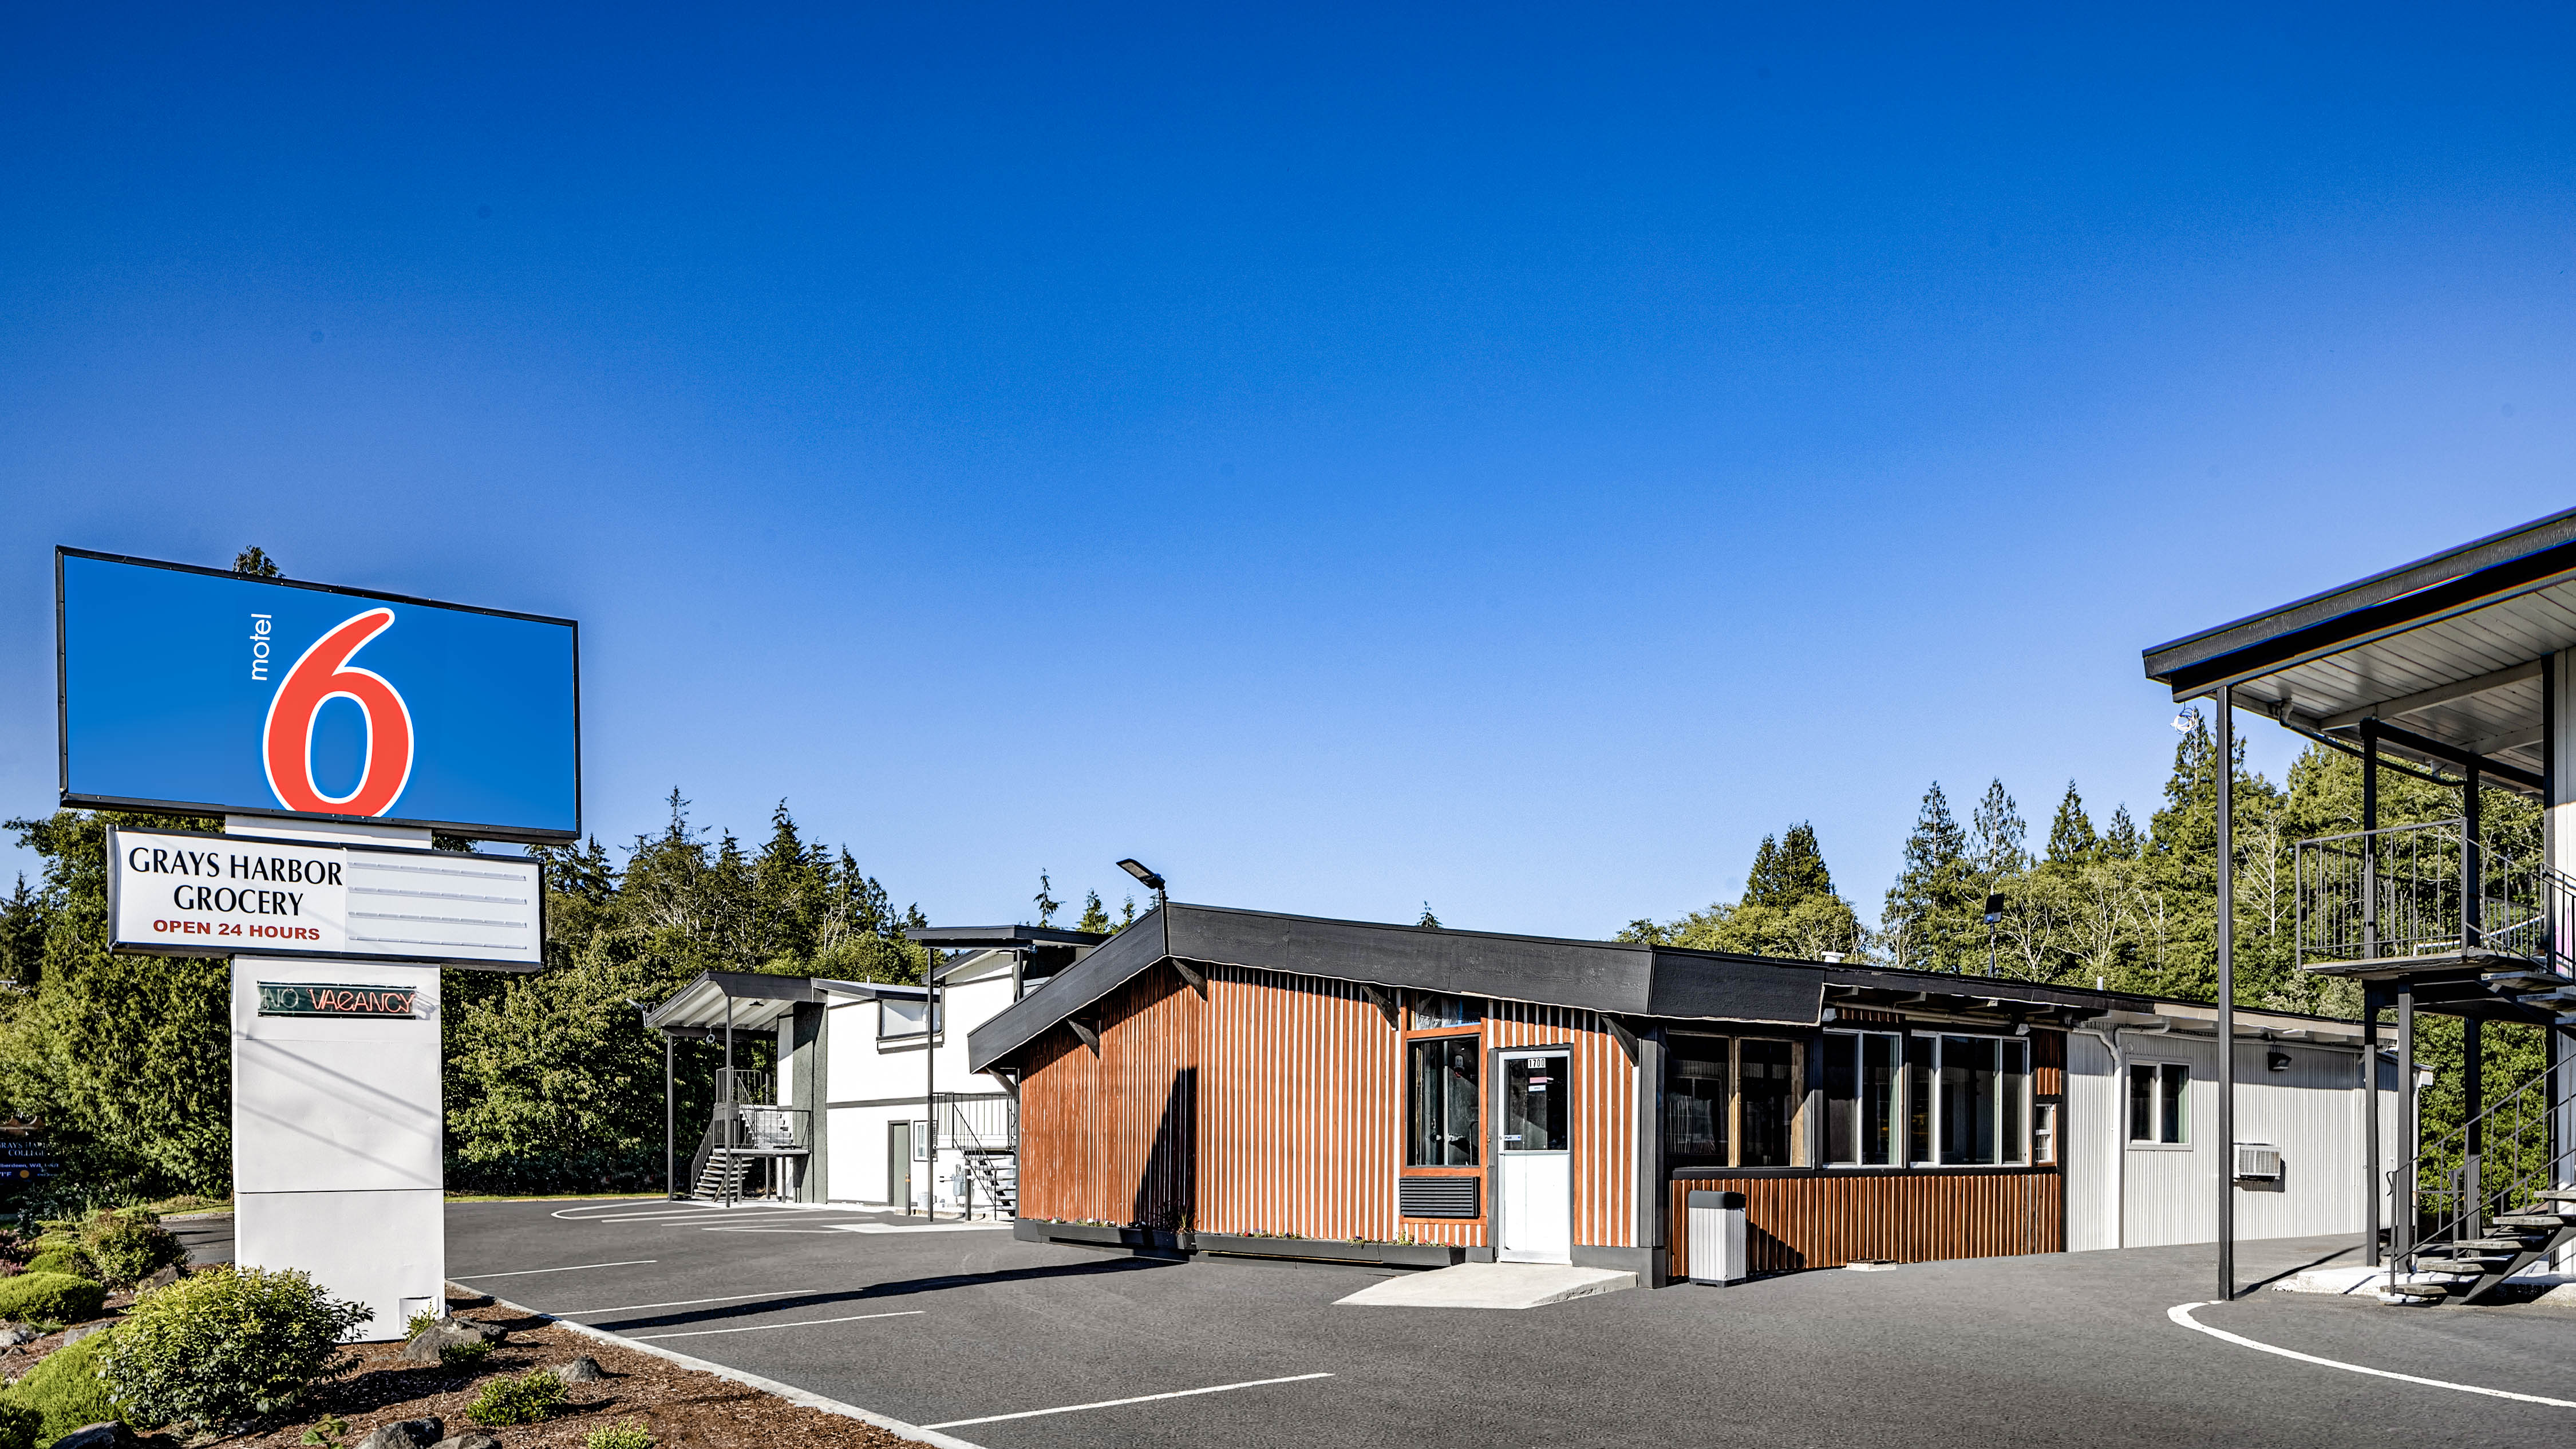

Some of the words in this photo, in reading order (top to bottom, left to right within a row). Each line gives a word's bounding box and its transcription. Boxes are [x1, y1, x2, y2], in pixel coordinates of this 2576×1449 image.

[250, 614, 271, 681] motel
[263, 607, 414, 818] 6
[129, 847, 219, 877] GRAYS
[230, 855, 343, 886] HARBOR
[173, 885, 303, 915] GROCERY
[153, 919, 210, 934] OPEN
[219, 923, 242, 936] 24
[250, 925, 319, 940] HOURS
[261, 987, 298, 1008] NO
[307, 988, 415, 1013] VACANCY
[1529, 1059, 1544, 1067] 1700
